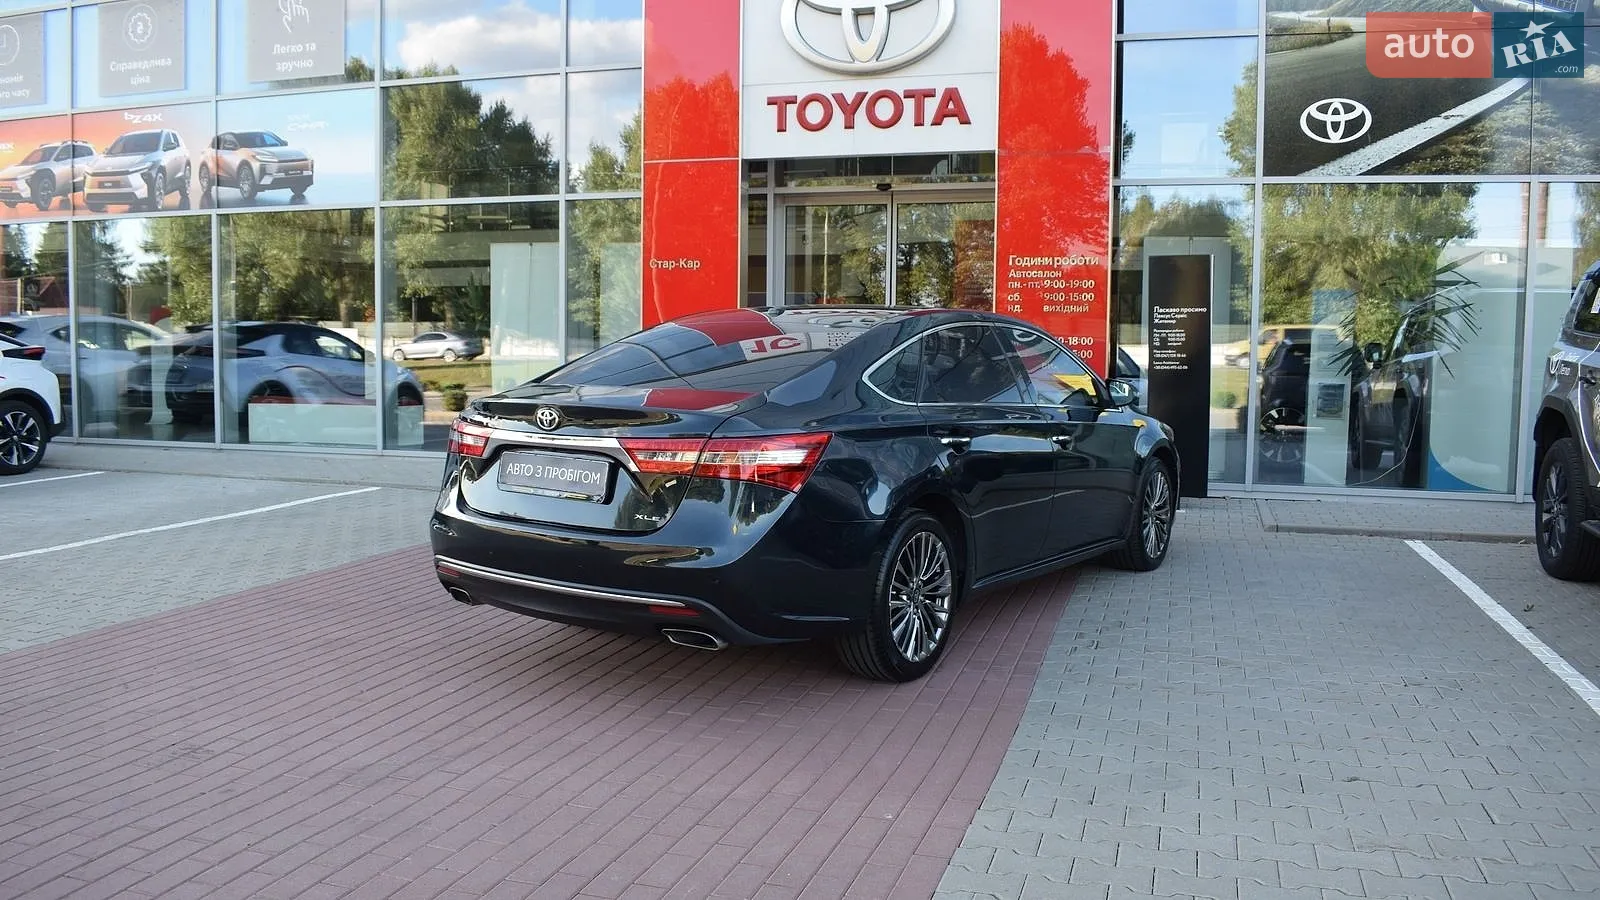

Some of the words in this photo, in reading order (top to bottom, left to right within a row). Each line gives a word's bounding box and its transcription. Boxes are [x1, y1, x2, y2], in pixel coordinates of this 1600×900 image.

[272, 44, 303, 55] Легко
[304, 43, 317, 52] та
[109, 57, 172, 73] Справедлива
[275, 59, 314, 72] зручно
[130, 74, 151, 87] ціна
[766, 87, 971, 133] TOYOTA
[649, 258, 700, 270] Стар-Кар
[1008, 255, 1052, 267] Години
[1054, 254, 1099, 268] роботи
[1008, 269, 1061, 278] Автосалон
[1007, 293, 1023, 301] сб.
[1044, 292, 1095, 301] 9:00-15:00
[1007, 304, 1023, 313] нд.
[1043, 303, 1089, 313] вихідний
[506, 463, 534, 476] АВТО
[544, 466, 601, 485] ПРОБІГОМ
[633, 514, 661, 522] XLE
